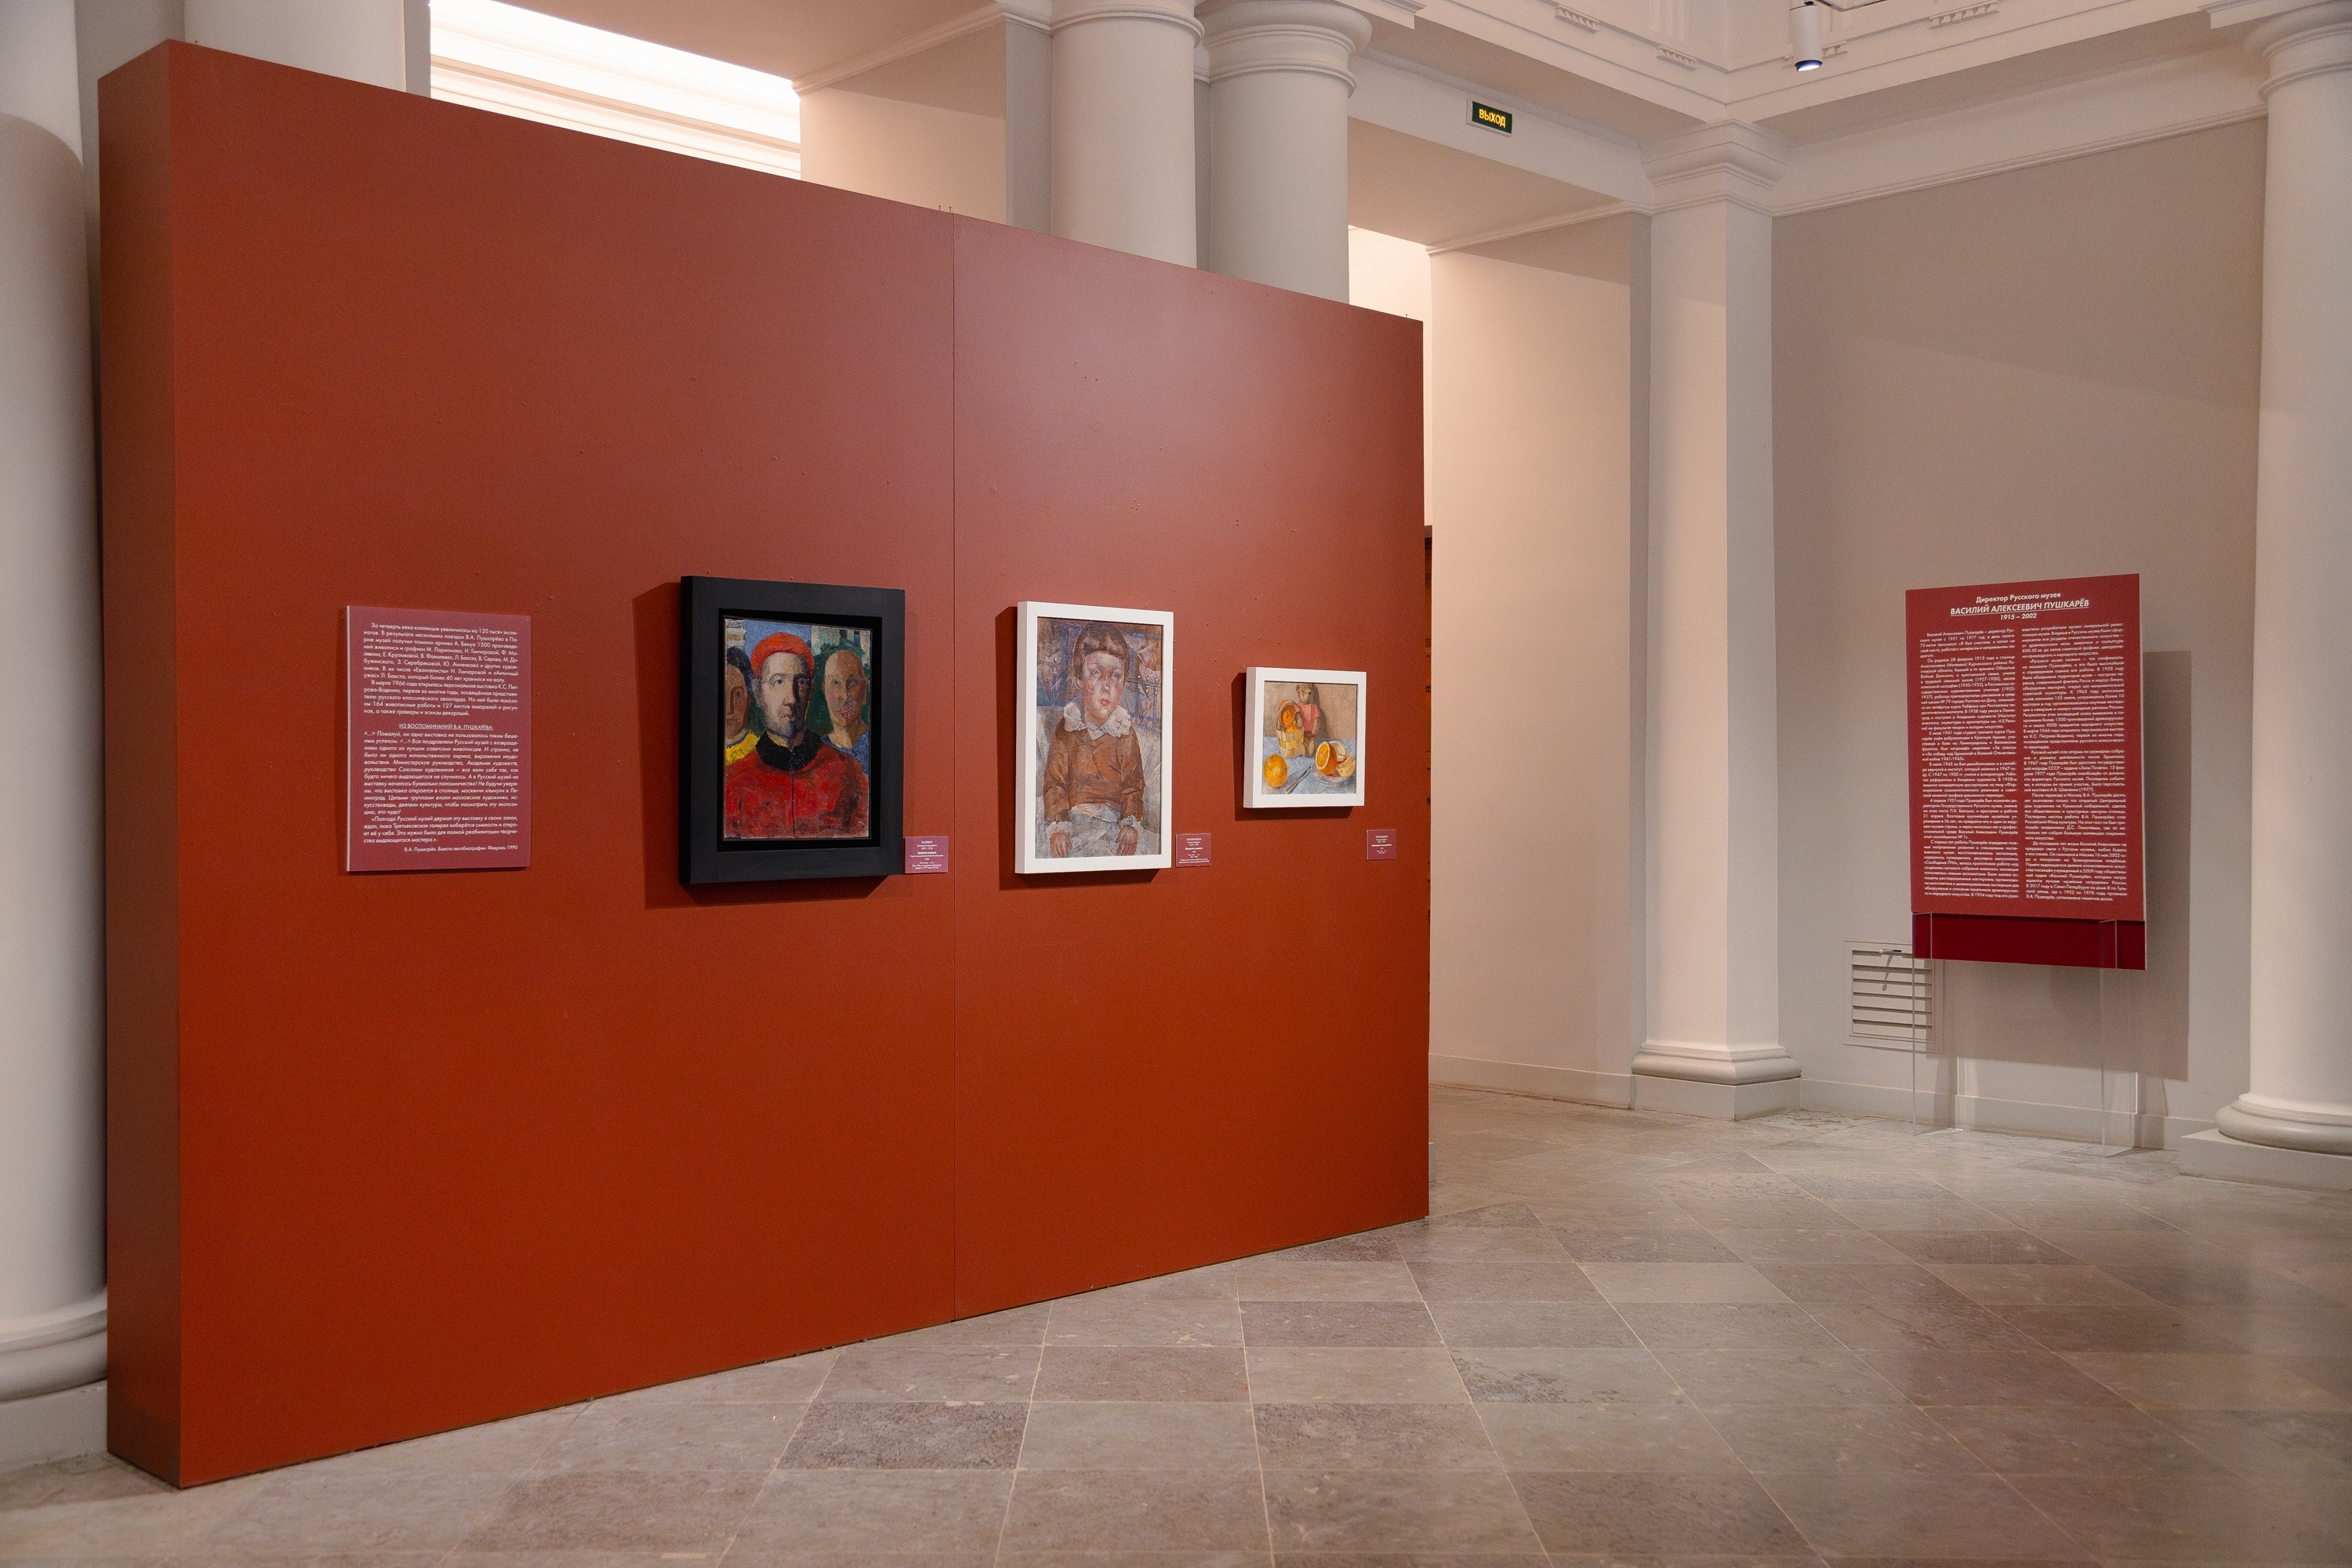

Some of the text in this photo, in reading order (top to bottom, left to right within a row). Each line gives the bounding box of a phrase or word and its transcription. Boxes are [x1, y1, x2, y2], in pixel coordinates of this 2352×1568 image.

[1479, 108, 1506, 129] ВЫХОД
[1951, 598, 2089, 615] ВАСИЛИЙ АЛЕКСЕЕВИЧ ПУШКАРЁВ
[477, 634, 504, 643] Пушкарёва
[434, 646, 463, 655] Ларионова,
